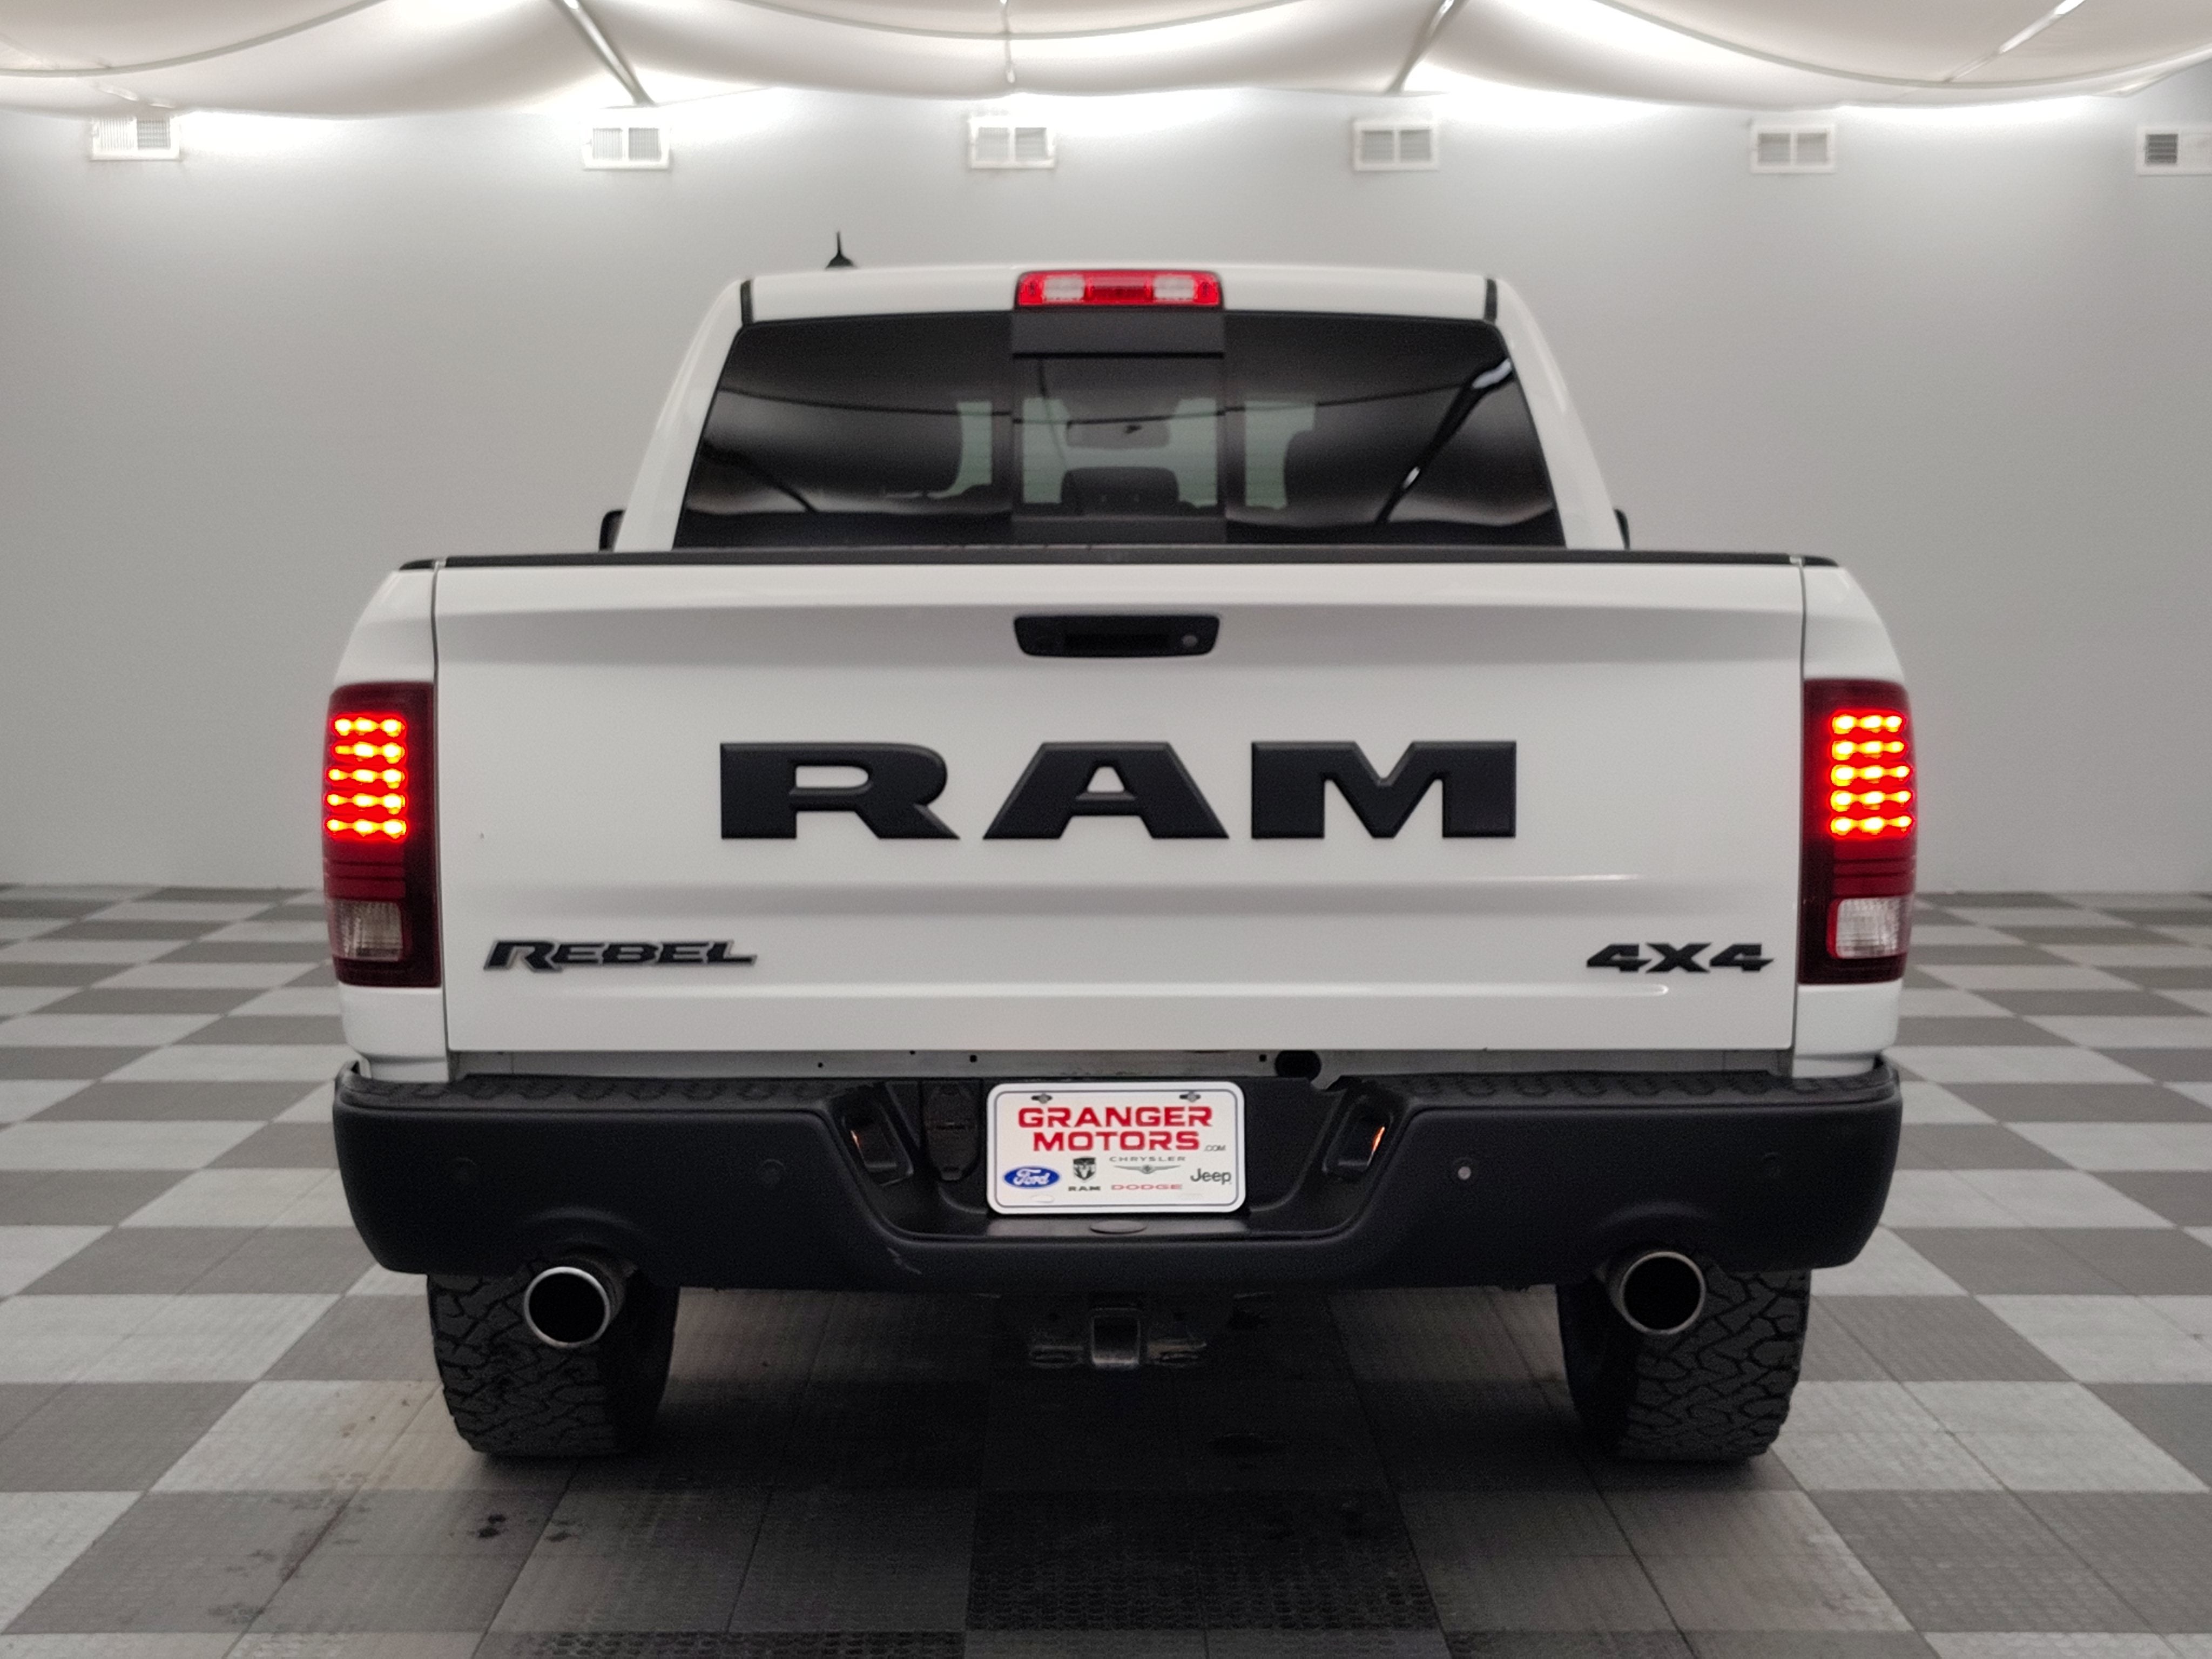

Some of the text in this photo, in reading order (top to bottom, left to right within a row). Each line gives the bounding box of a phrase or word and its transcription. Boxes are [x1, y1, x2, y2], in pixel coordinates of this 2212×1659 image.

[720, 740, 1516, 840] RAM
[1018, 1107, 1213, 1128] GRANGER
[1033, 1131, 1200, 1151] MOTORS
[1013, 1168, 1050, 1186] Ford
[1190, 1168, 1232, 1185] Jeep
